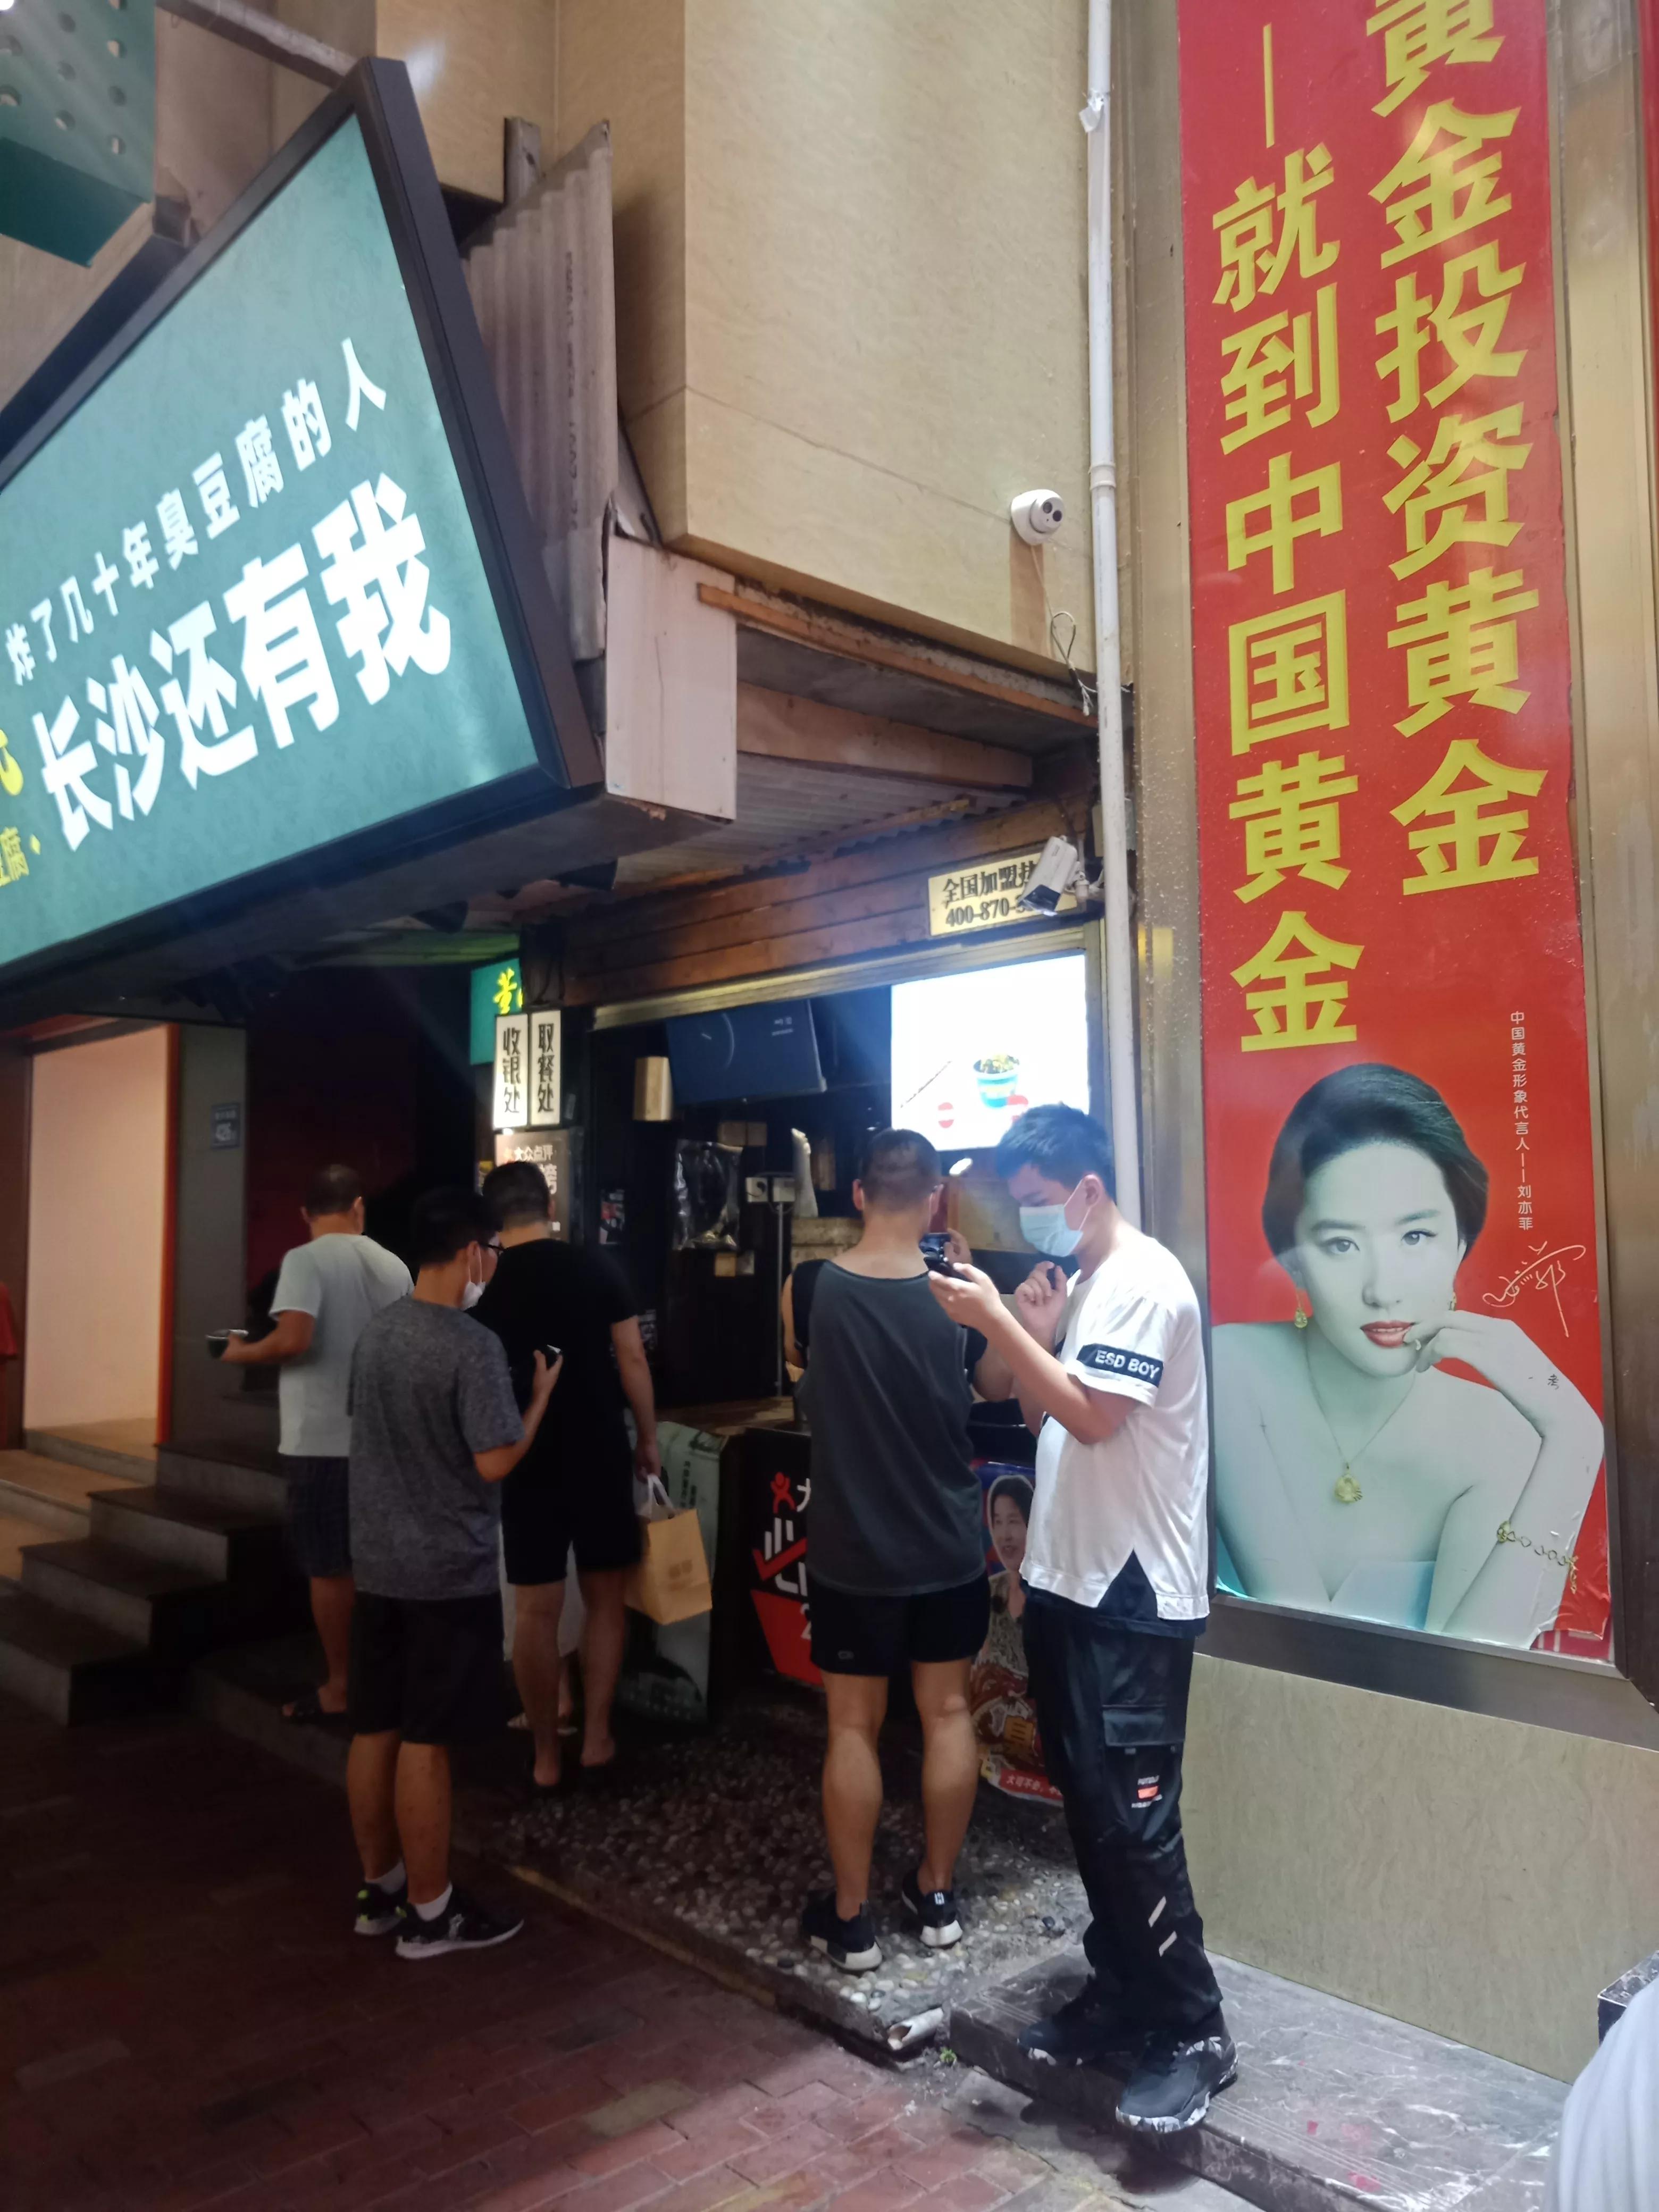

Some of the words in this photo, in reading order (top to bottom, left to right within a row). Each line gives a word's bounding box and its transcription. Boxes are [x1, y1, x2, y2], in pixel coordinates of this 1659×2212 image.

[5, 337, 387, 686] 炸了几十年臭豆腐的人
[31, 472, 451, 851] 长沙还有我
[502, 1027, 521, 1113] 收银处
[538, 1023, 555, 1113] 取餐处
[1095, 1349, 1126, 1368] ESD
[1127, 1358, 1160, 1379] BOY
